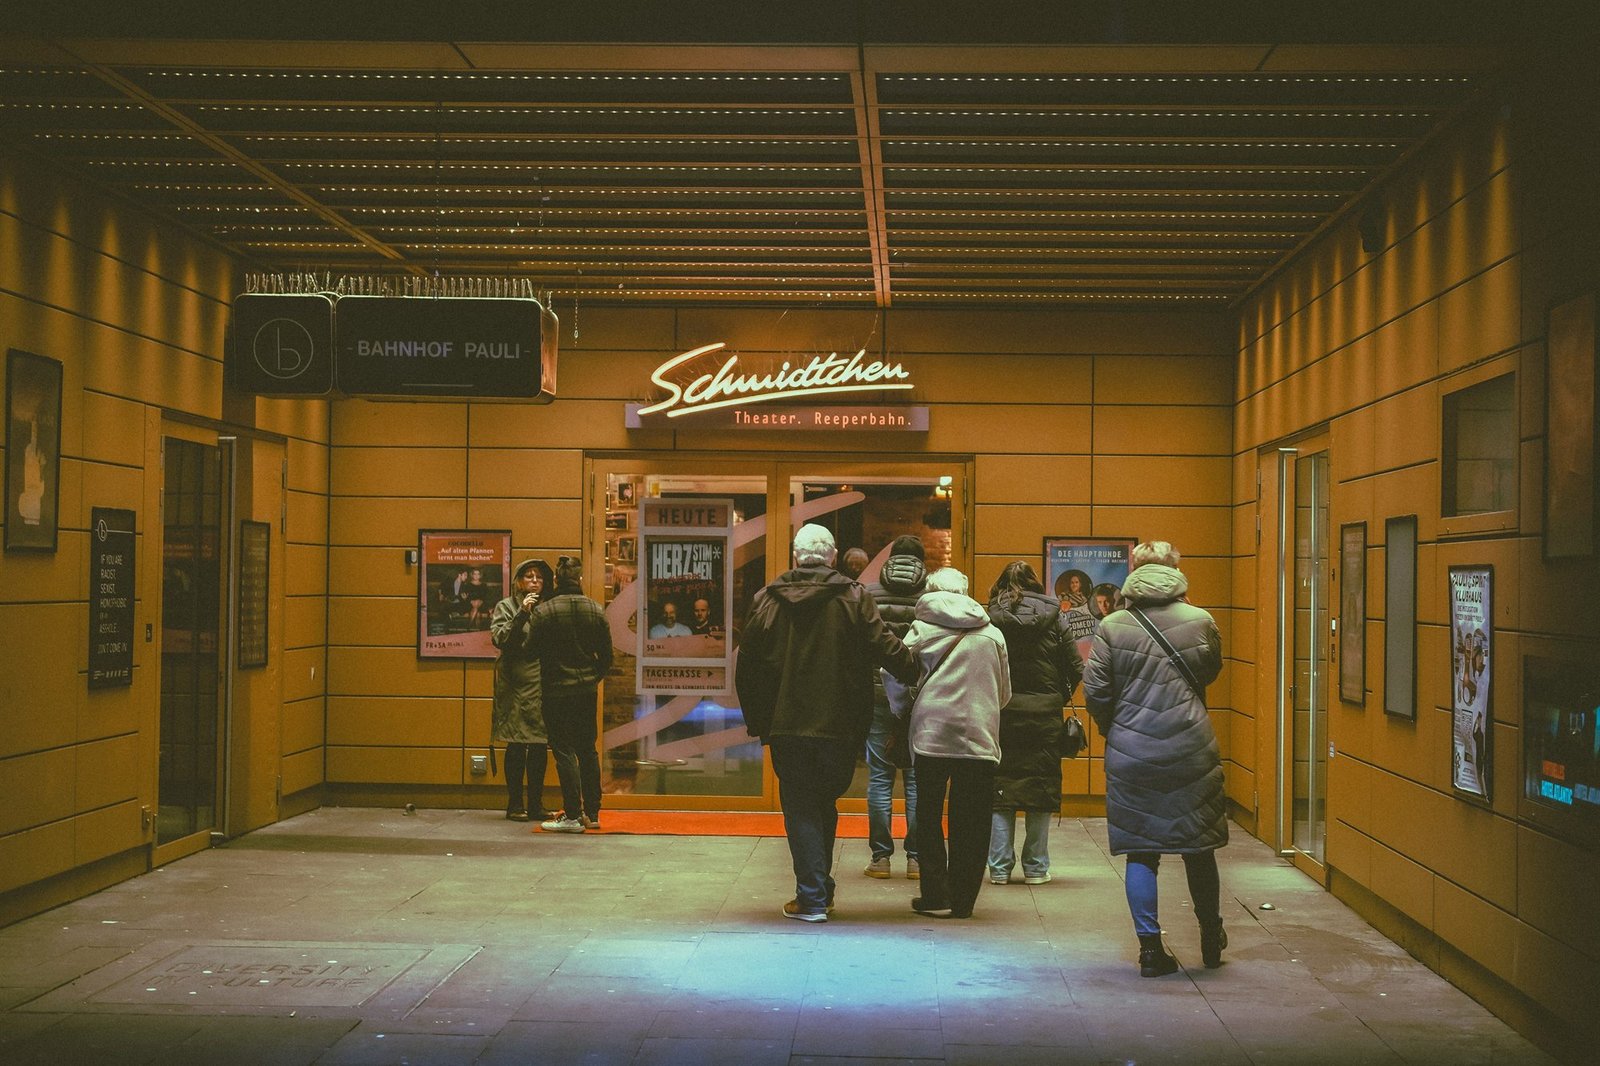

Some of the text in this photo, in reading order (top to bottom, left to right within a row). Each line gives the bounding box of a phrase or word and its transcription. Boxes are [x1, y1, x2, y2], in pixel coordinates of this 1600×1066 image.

[357, 340, 520, 359] BAHNHOF PAULI
[637, 342, 909, 415] Schmidtchen
[735, 410, 912, 428] Theater. Reeperbahn.
[657, 507, 717, 525] HEUTE
[652, 543, 712, 579] HERZ STIM
[1057, 550, 1122, 558] DIE HAUPTRUNDE
[693, 561, 712, 580] MEN
[1072, 627, 1093, 638] POKAL
[646, 669, 701, 678] TAGESKASSE
